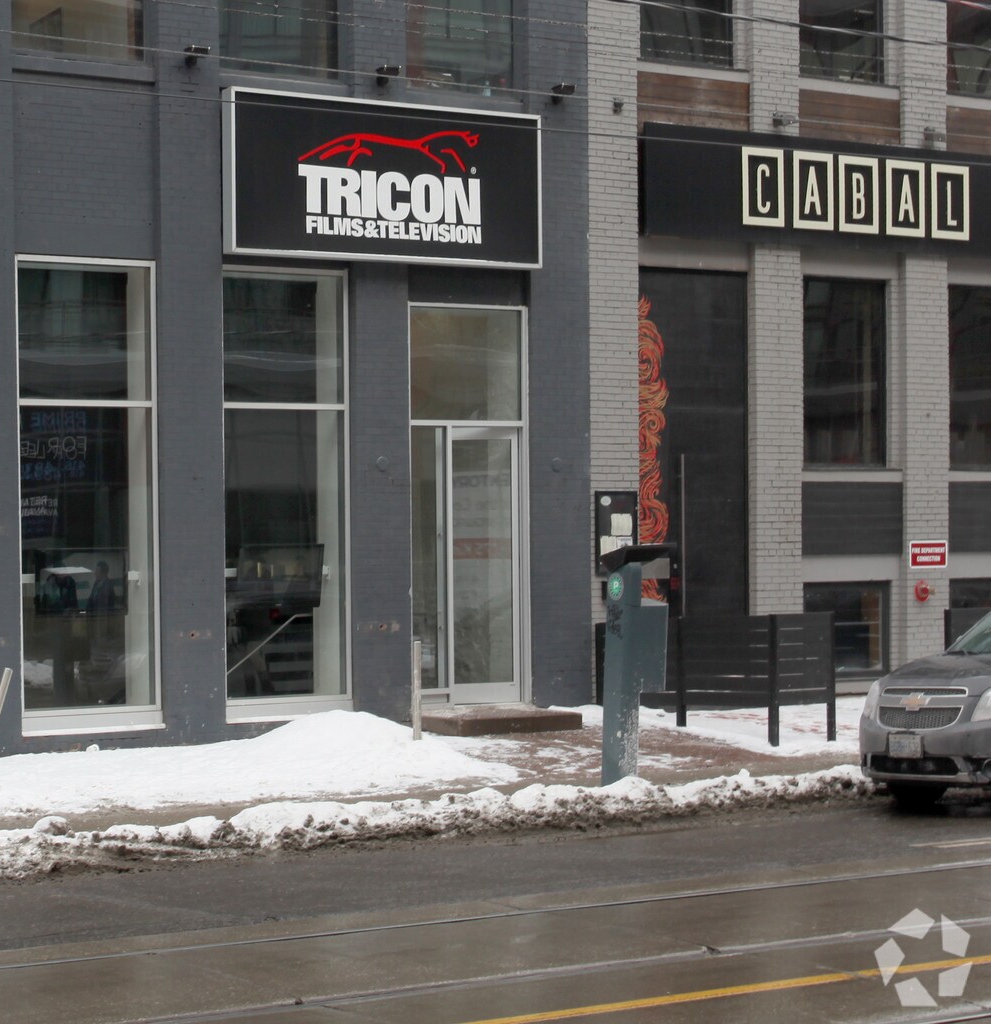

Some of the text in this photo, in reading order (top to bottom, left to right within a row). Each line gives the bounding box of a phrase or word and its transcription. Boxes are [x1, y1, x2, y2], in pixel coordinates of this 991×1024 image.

[297, 163, 482, 226] TRICON
[754, 162, 958, 227] CABAL
[305, 215, 482, 244] FILMS&TELEVISION
